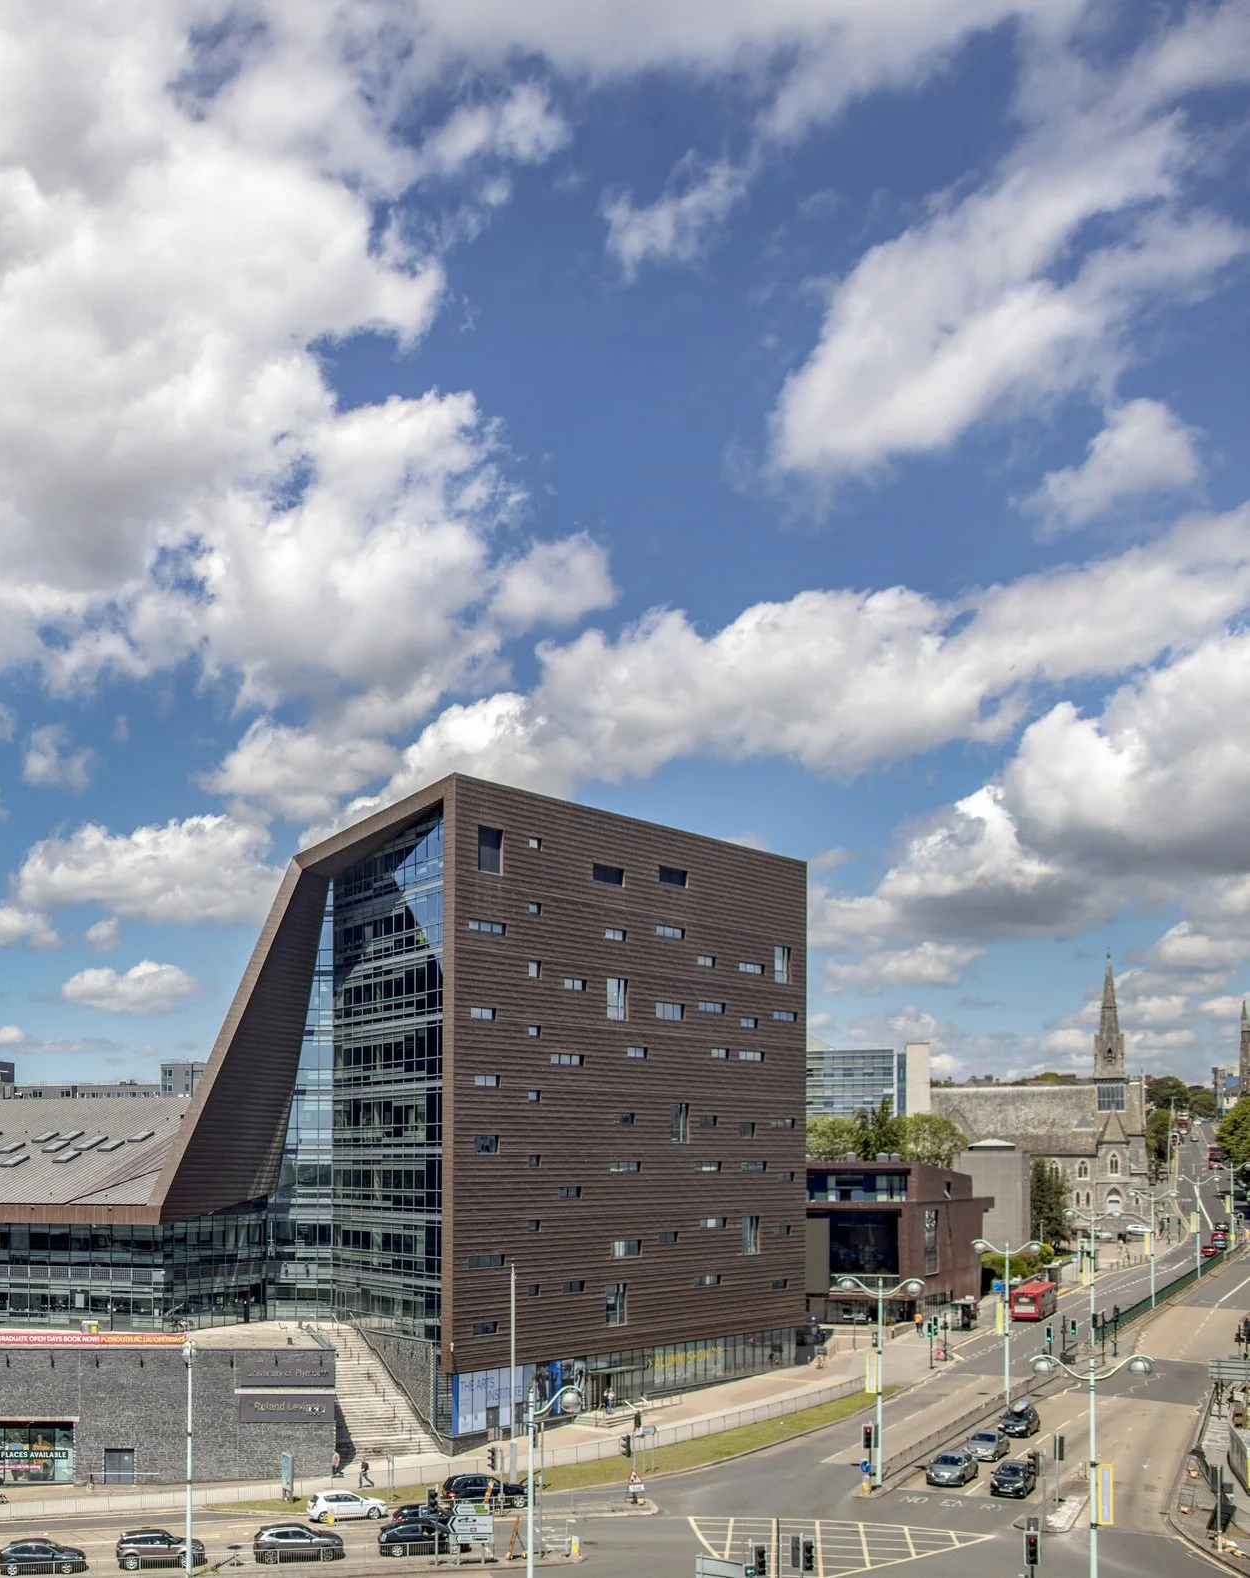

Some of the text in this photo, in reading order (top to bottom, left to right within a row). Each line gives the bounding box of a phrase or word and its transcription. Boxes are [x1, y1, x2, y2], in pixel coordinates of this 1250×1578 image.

[654, 1352, 685, 1368] ALUMNI
[686, 1347, 710, 1364] SHOW
[247, 1368, 329, 1379] University of Plymouth
[460, 1376, 495, 1392] THE ARTS
[487, 1385, 522, 1400] INSTITTE
[254, 1402, 286, 1412] Roland
[898, 1496, 1007, 1511] NO ENRY
